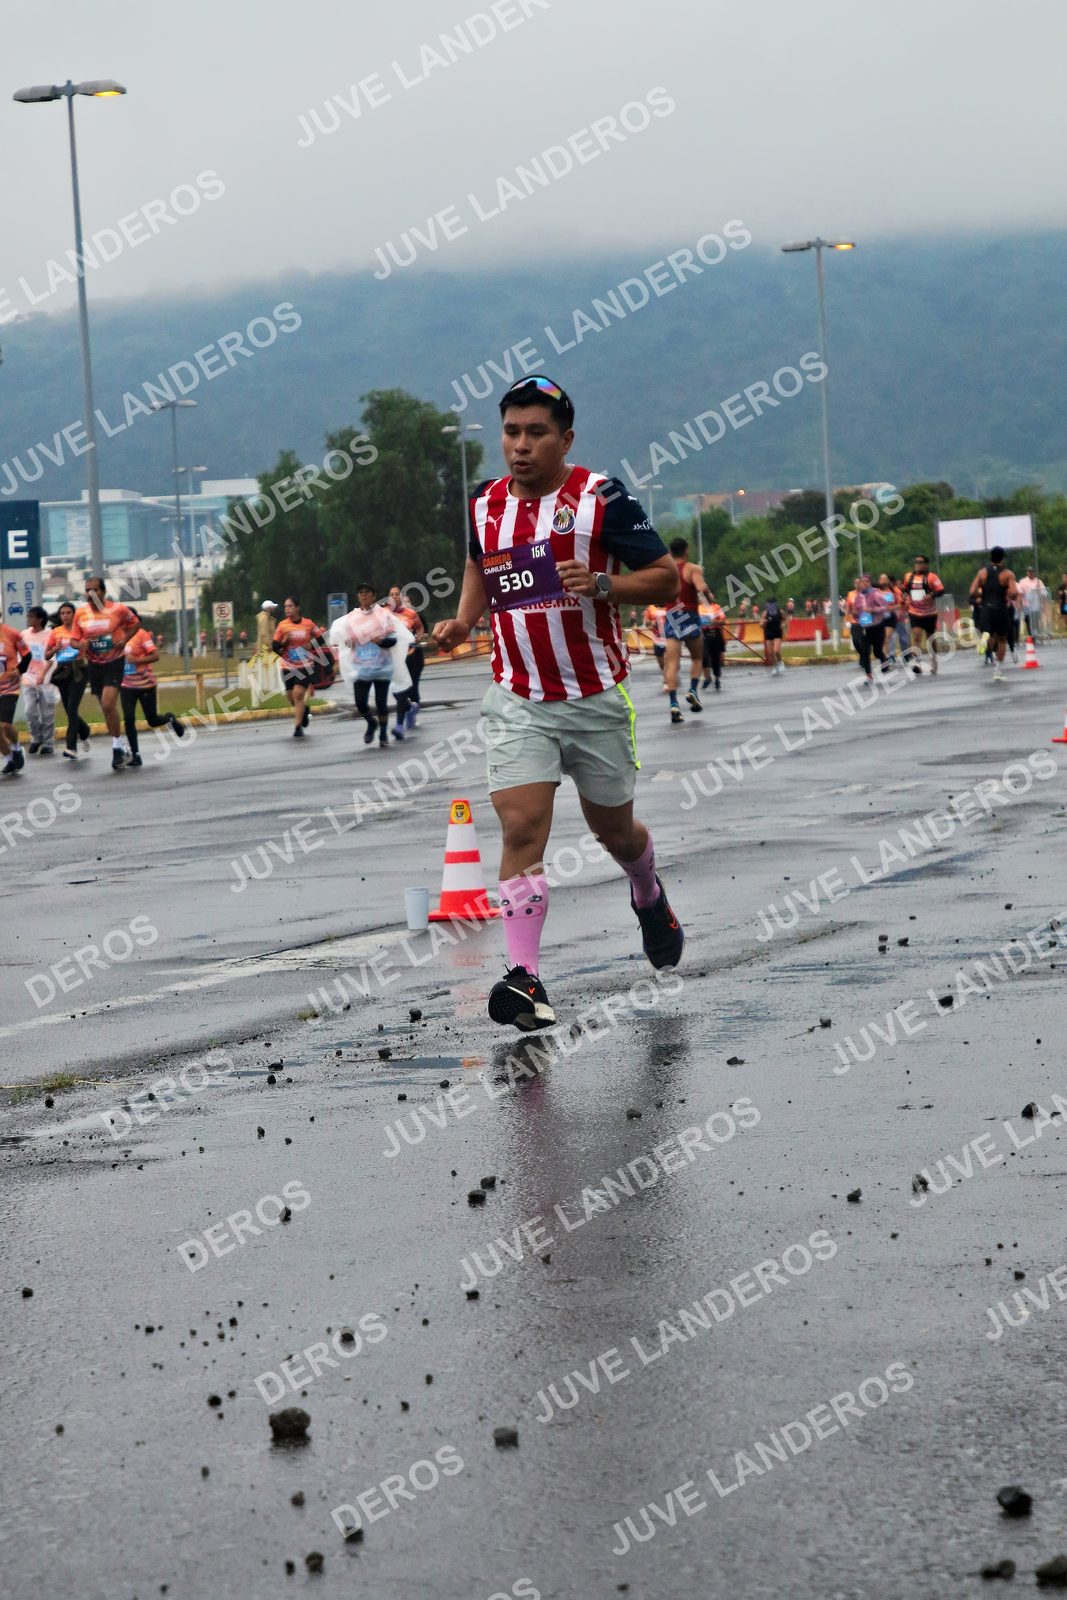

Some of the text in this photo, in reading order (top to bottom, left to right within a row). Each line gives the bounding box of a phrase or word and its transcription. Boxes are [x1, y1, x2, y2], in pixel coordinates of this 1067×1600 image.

[7, 529, 29, 559] E
[483, 553, 512, 568] CARRERA
[499, 570, 534, 593] 530
